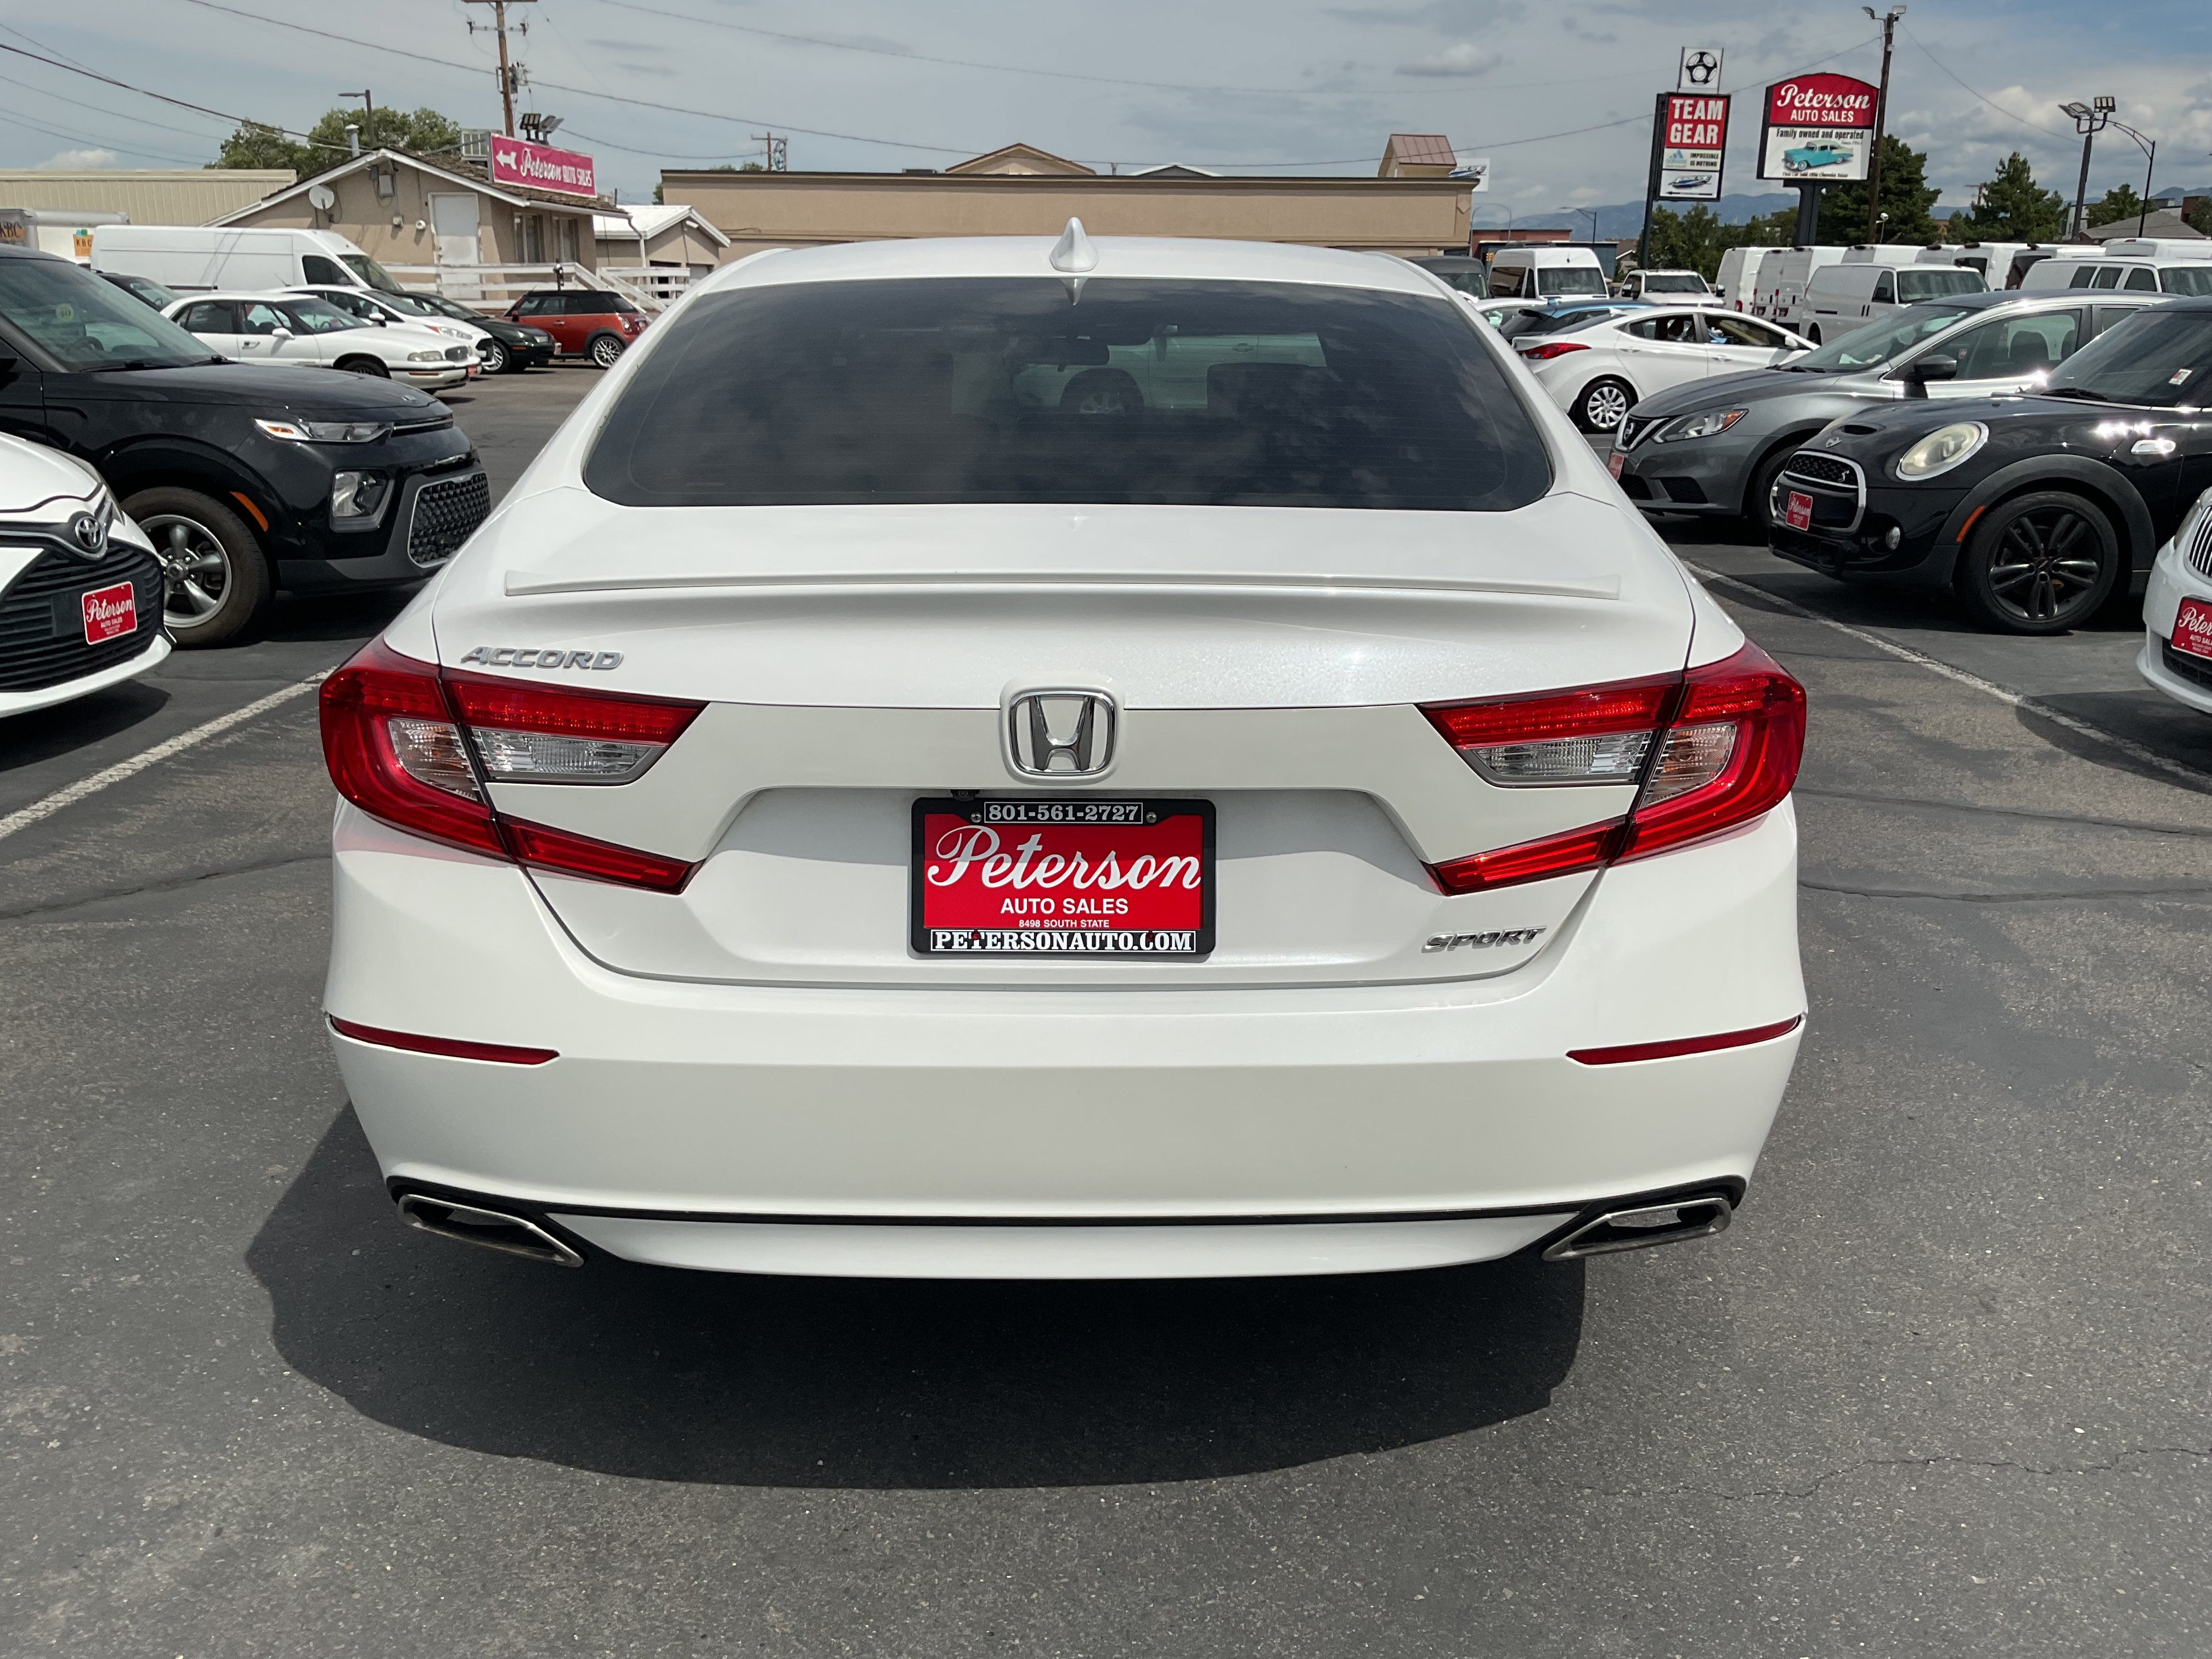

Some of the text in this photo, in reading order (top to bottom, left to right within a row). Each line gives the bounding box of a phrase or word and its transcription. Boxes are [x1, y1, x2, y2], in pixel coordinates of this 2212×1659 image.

[1776, 84, 1870, 109] Peterson
[1672, 99, 1723, 120] TEAM
[1791, 110, 1854, 122] AUTO SALES
[1670, 123, 1718, 144] GEAR
[1776, 128, 1864, 140] Family owned and operated
[520, 148, 562, 181] Peterson
[577, 168, 592, 187] SALES
[76, 239, 92, 247] KBC
[86, 599, 133, 623] Peterson
[100, 619, 111, 628] AUTO
[111, 616, 123, 625] SALES
[2190, 634, 2202, 642] AUTO
[461, 646, 624, 670] ACCORD
[989, 805, 1139, 821] 801-561-2727
[928, 825, 1201, 890] Peterson
[1000, 898, 1128, 915] AUTO SALES
[1019, 919, 1110, 928] 8498 SOUTH STATE
[935, 930, 1192, 951] PETERSONAUTO.COM
[1421, 926, 1548, 953] SPORT
